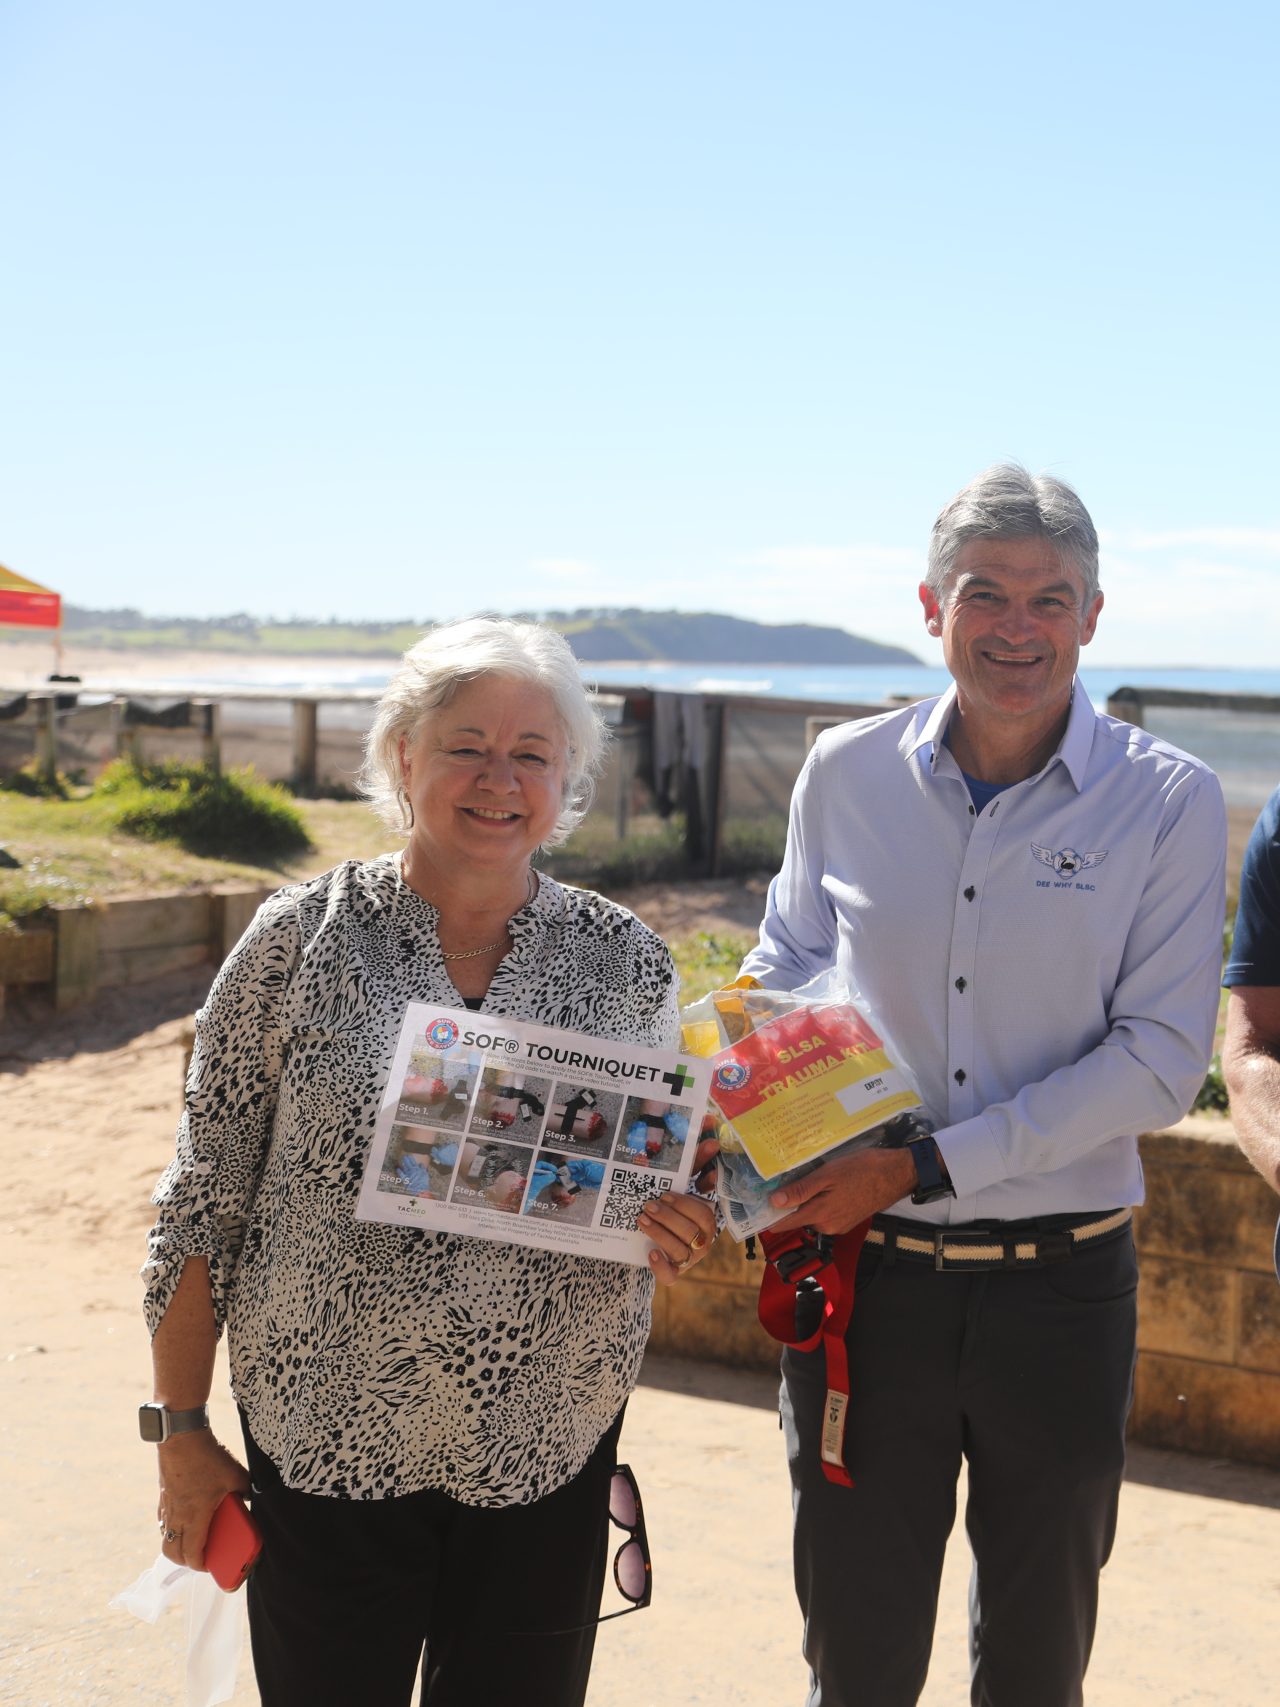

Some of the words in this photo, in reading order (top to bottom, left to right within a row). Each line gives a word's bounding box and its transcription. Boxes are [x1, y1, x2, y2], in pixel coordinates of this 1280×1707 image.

[1036, 880, 1050, 888] DEE
[1054, 881, 1072, 889] WHY
[1075, 883, 1096, 891] SLSC
[777, 1035, 826, 1064] SLSA
[525, 1042, 661, 1082] TOURNIQUET
[758, 1055, 840, 1100] TRAUMA
[398, 1103, 421, 1115] Step
[471, 1116, 494, 1128] Step
[545, 1130, 567, 1142] Step
[616, 1144, 638, 1156] Step
[379, 1173, 402, 1185] Step
[454, 1185, 477, 1197] Step
[527, 1200, 549, 1209] Step
